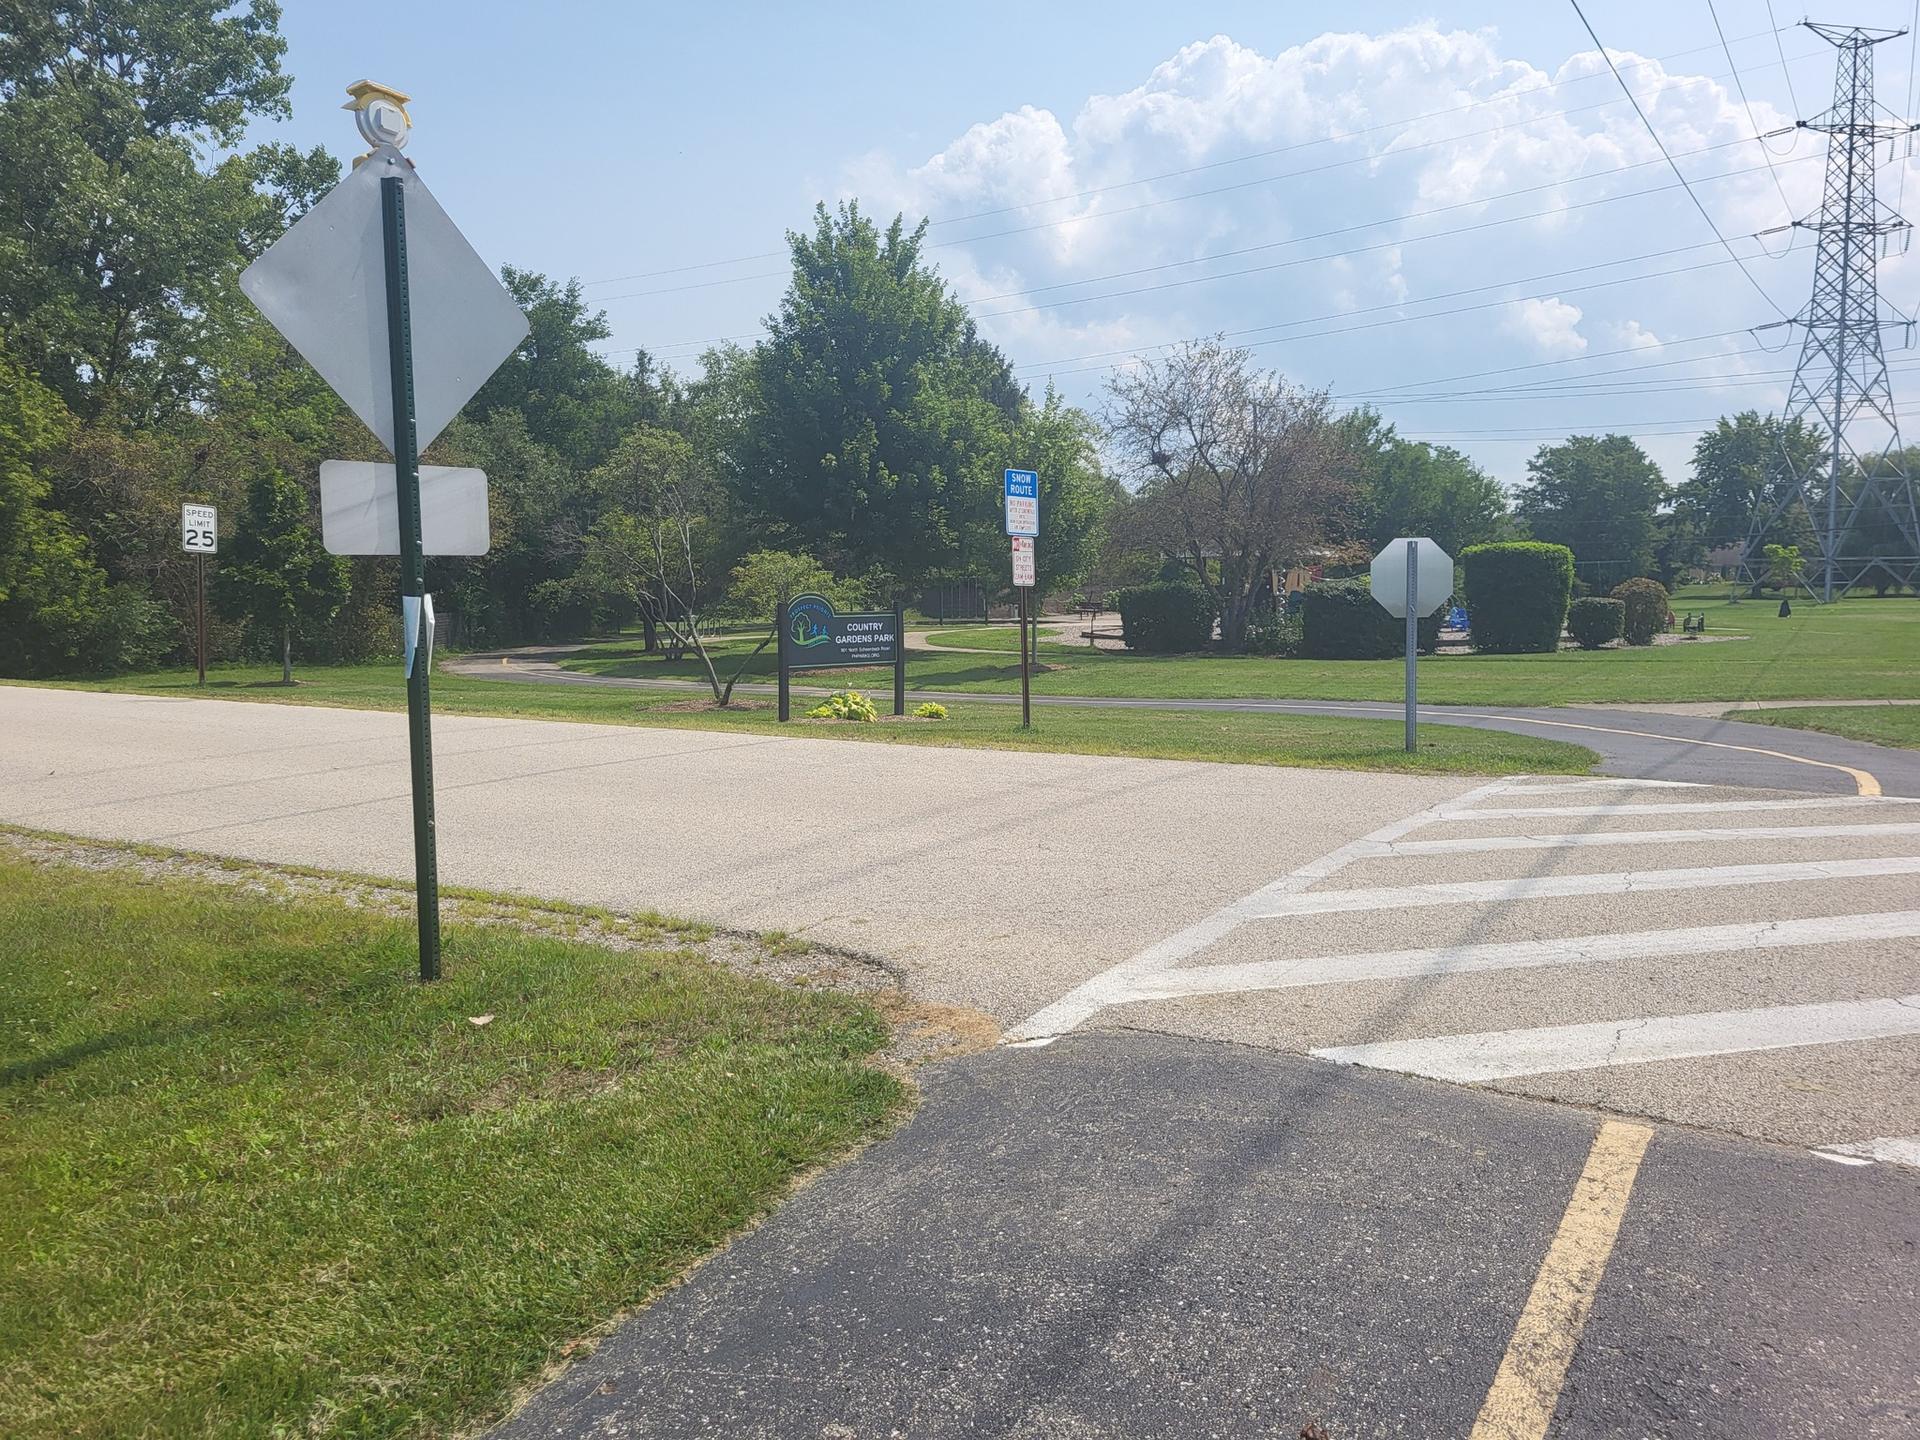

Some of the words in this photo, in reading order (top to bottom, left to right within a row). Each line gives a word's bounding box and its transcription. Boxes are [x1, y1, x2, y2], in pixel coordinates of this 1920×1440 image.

[1011, 472, 1032, 484] SNOW
[1010, 484, 1033, 496] ROUTE
[185, 509, 214, 519] SPEED
[188, 519, 211, 528] LIMIT
[186, 529, 214, 547] 25
[846, 622, 884, 632] COUNTRY
[835, 634, 873, 644] GARDENS
[874, 633, 895, 643] PARK
